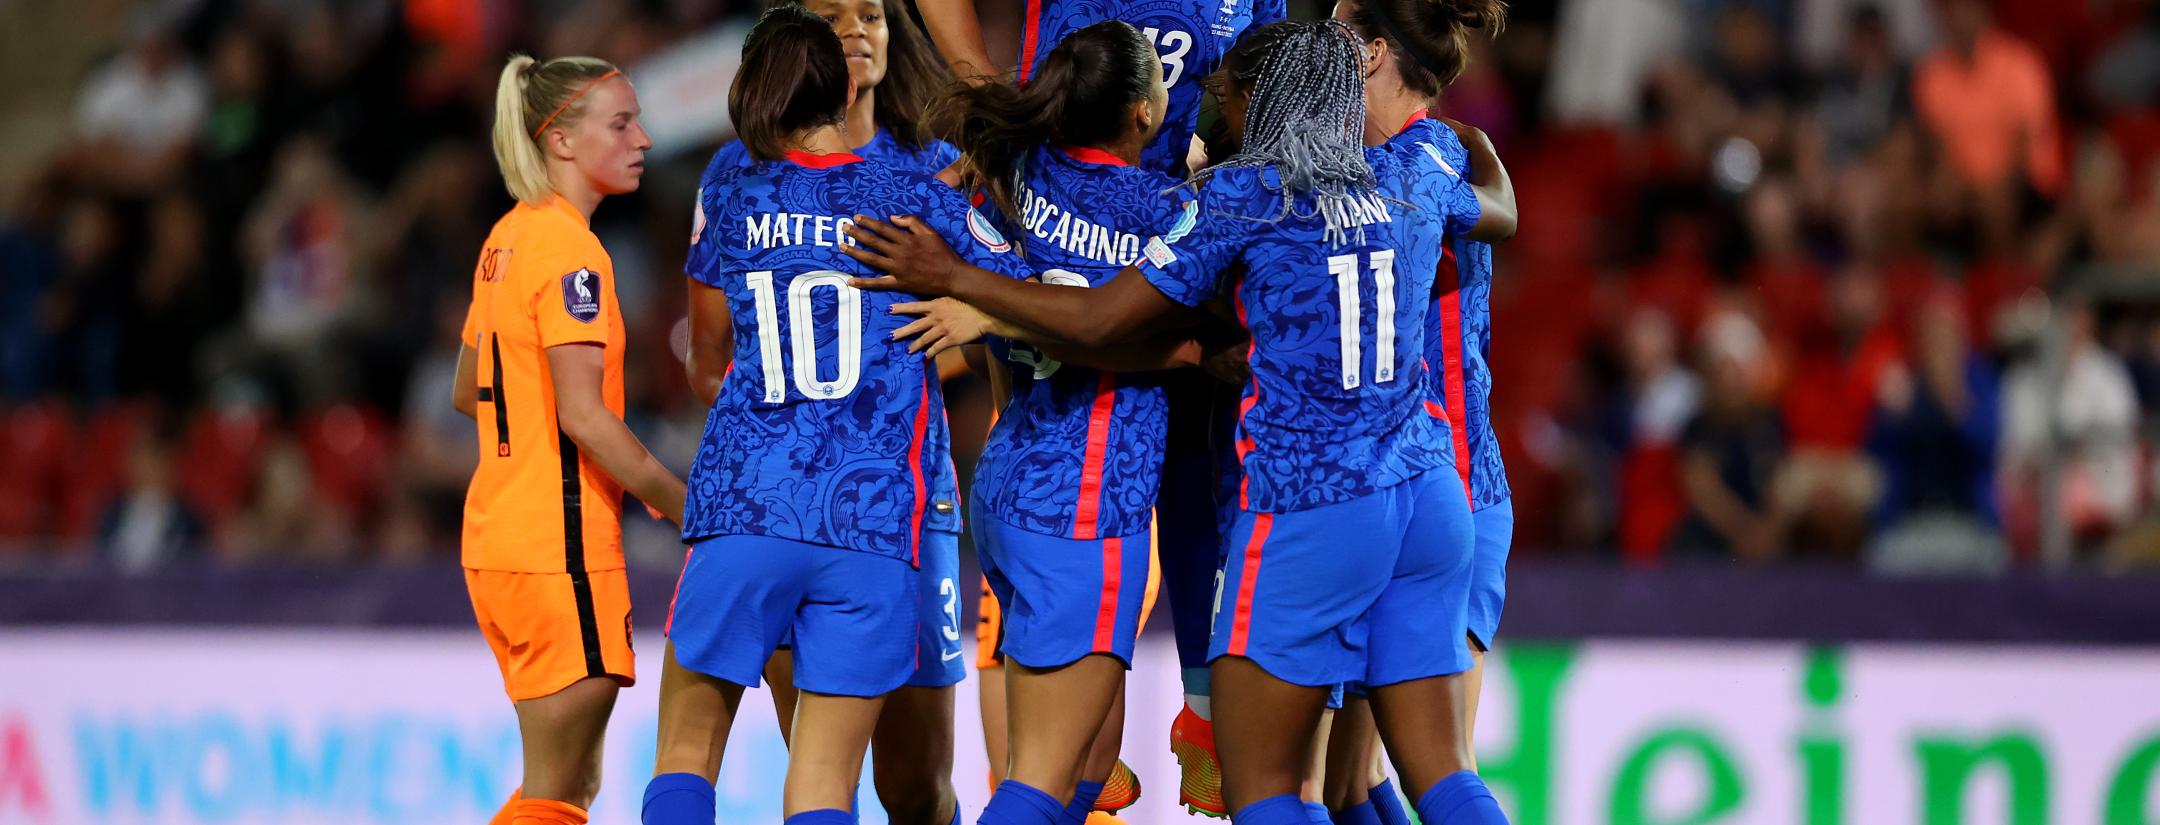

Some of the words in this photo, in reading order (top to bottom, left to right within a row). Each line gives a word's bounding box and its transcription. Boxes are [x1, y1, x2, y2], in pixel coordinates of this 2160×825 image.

[746, 270, 862, 403] 10
[1327, 249, 1395, 390] 11
[940, 577, 959, 641] 3
